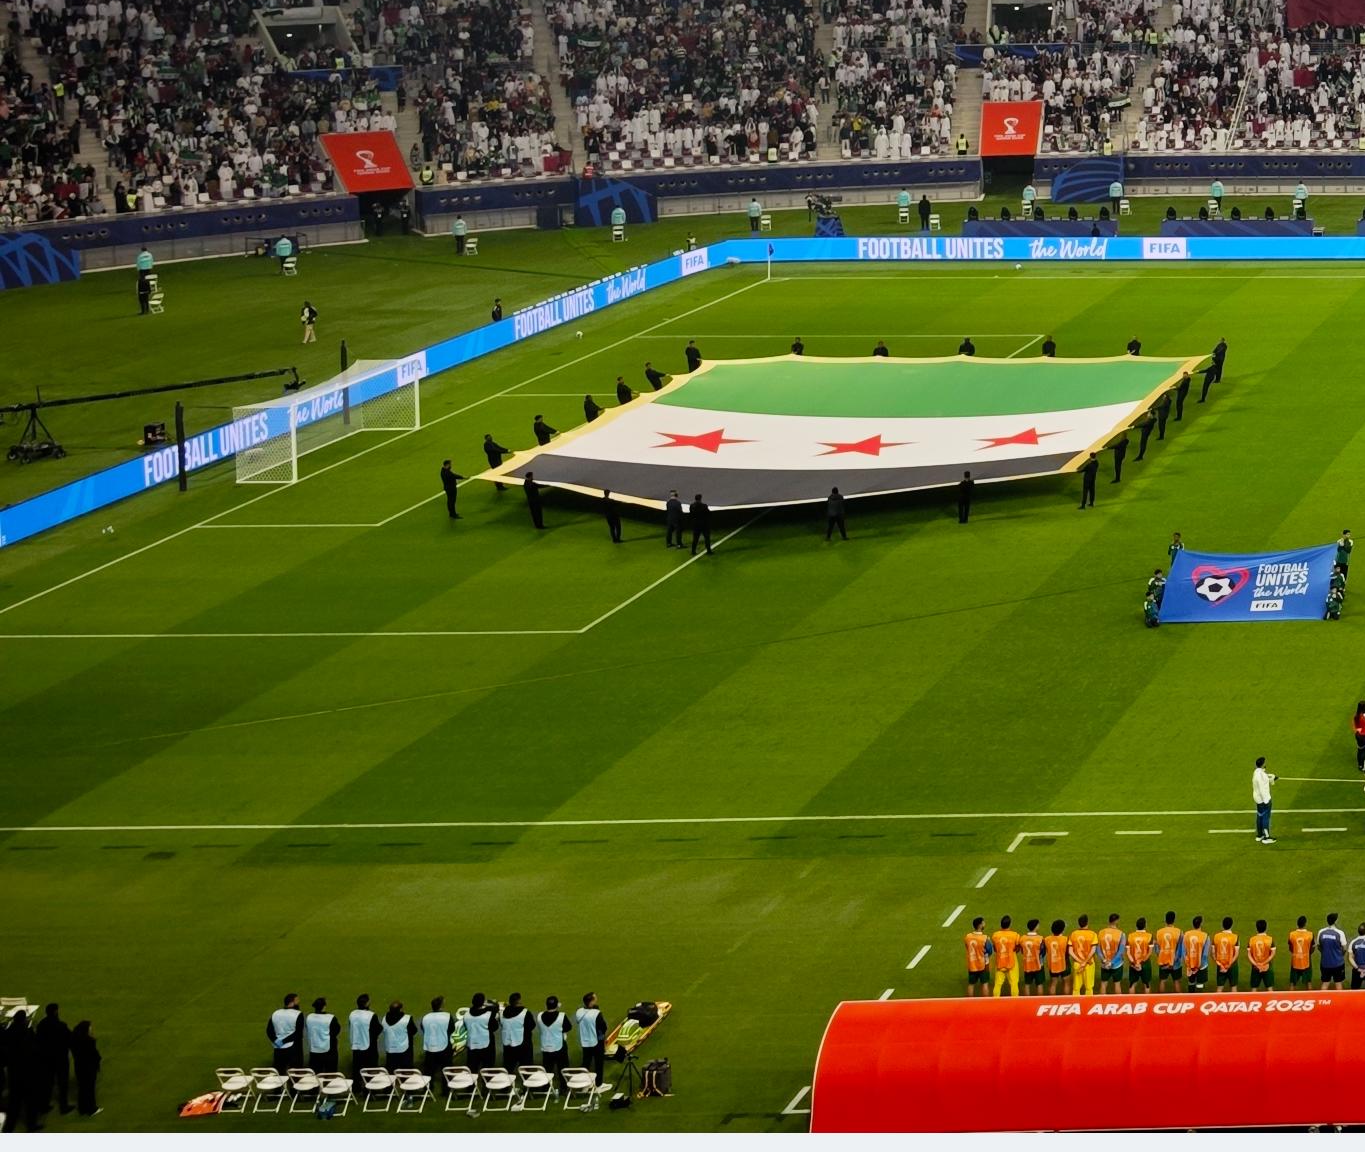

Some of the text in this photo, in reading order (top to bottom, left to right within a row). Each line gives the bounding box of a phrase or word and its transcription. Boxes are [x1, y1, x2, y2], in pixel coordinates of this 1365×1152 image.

[858, 237, 1108, 259] FOOTBALL UNITES the World
[1150, 242, 1181, 254] FIFA
[684, 254, 704, 269] FIFA
[515, 268, 646, 341] FOOTBALL UNITES the World
[220, 411, 268, 458] UNITES
[1257, 562, 1310, 574] FOOTBALL
[1255, 571, 1309, 587] UNITES
[1252, 583, 1310, 599] the World
[1036, 1002, 1082, 1017] FIFA
[1087, 1001, 1148, 1016] ARAB
[1152, 1001, 1195, 1015] CUP
[1200, 1000, 1262, 1014] QATAR
